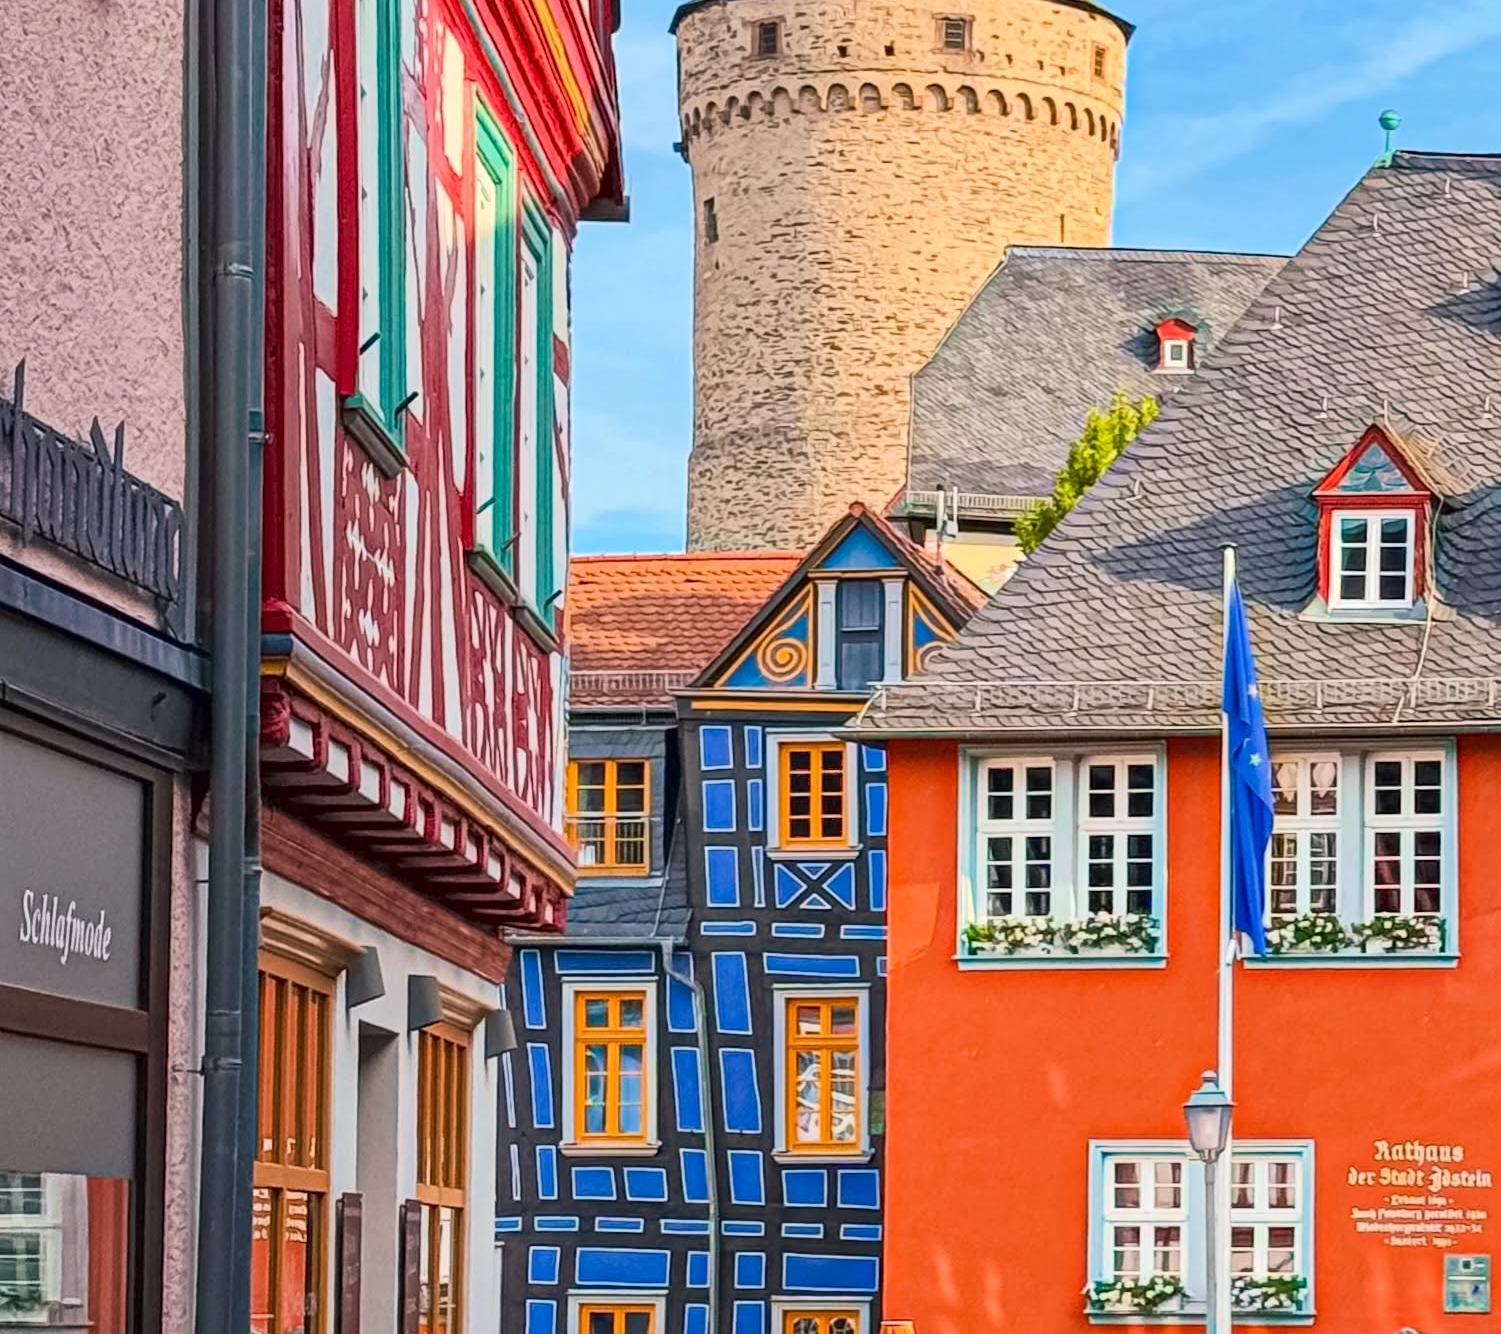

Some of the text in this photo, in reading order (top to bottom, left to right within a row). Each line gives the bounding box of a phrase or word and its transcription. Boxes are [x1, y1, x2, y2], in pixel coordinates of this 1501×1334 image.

[19, 889, 112, 965] Schlafmode
[1373, 1139, 1465, 1167] Rathaus
[1347, 1166, 1377, 1186] der
[1379, 1166, 1426, 1187] Stadt
